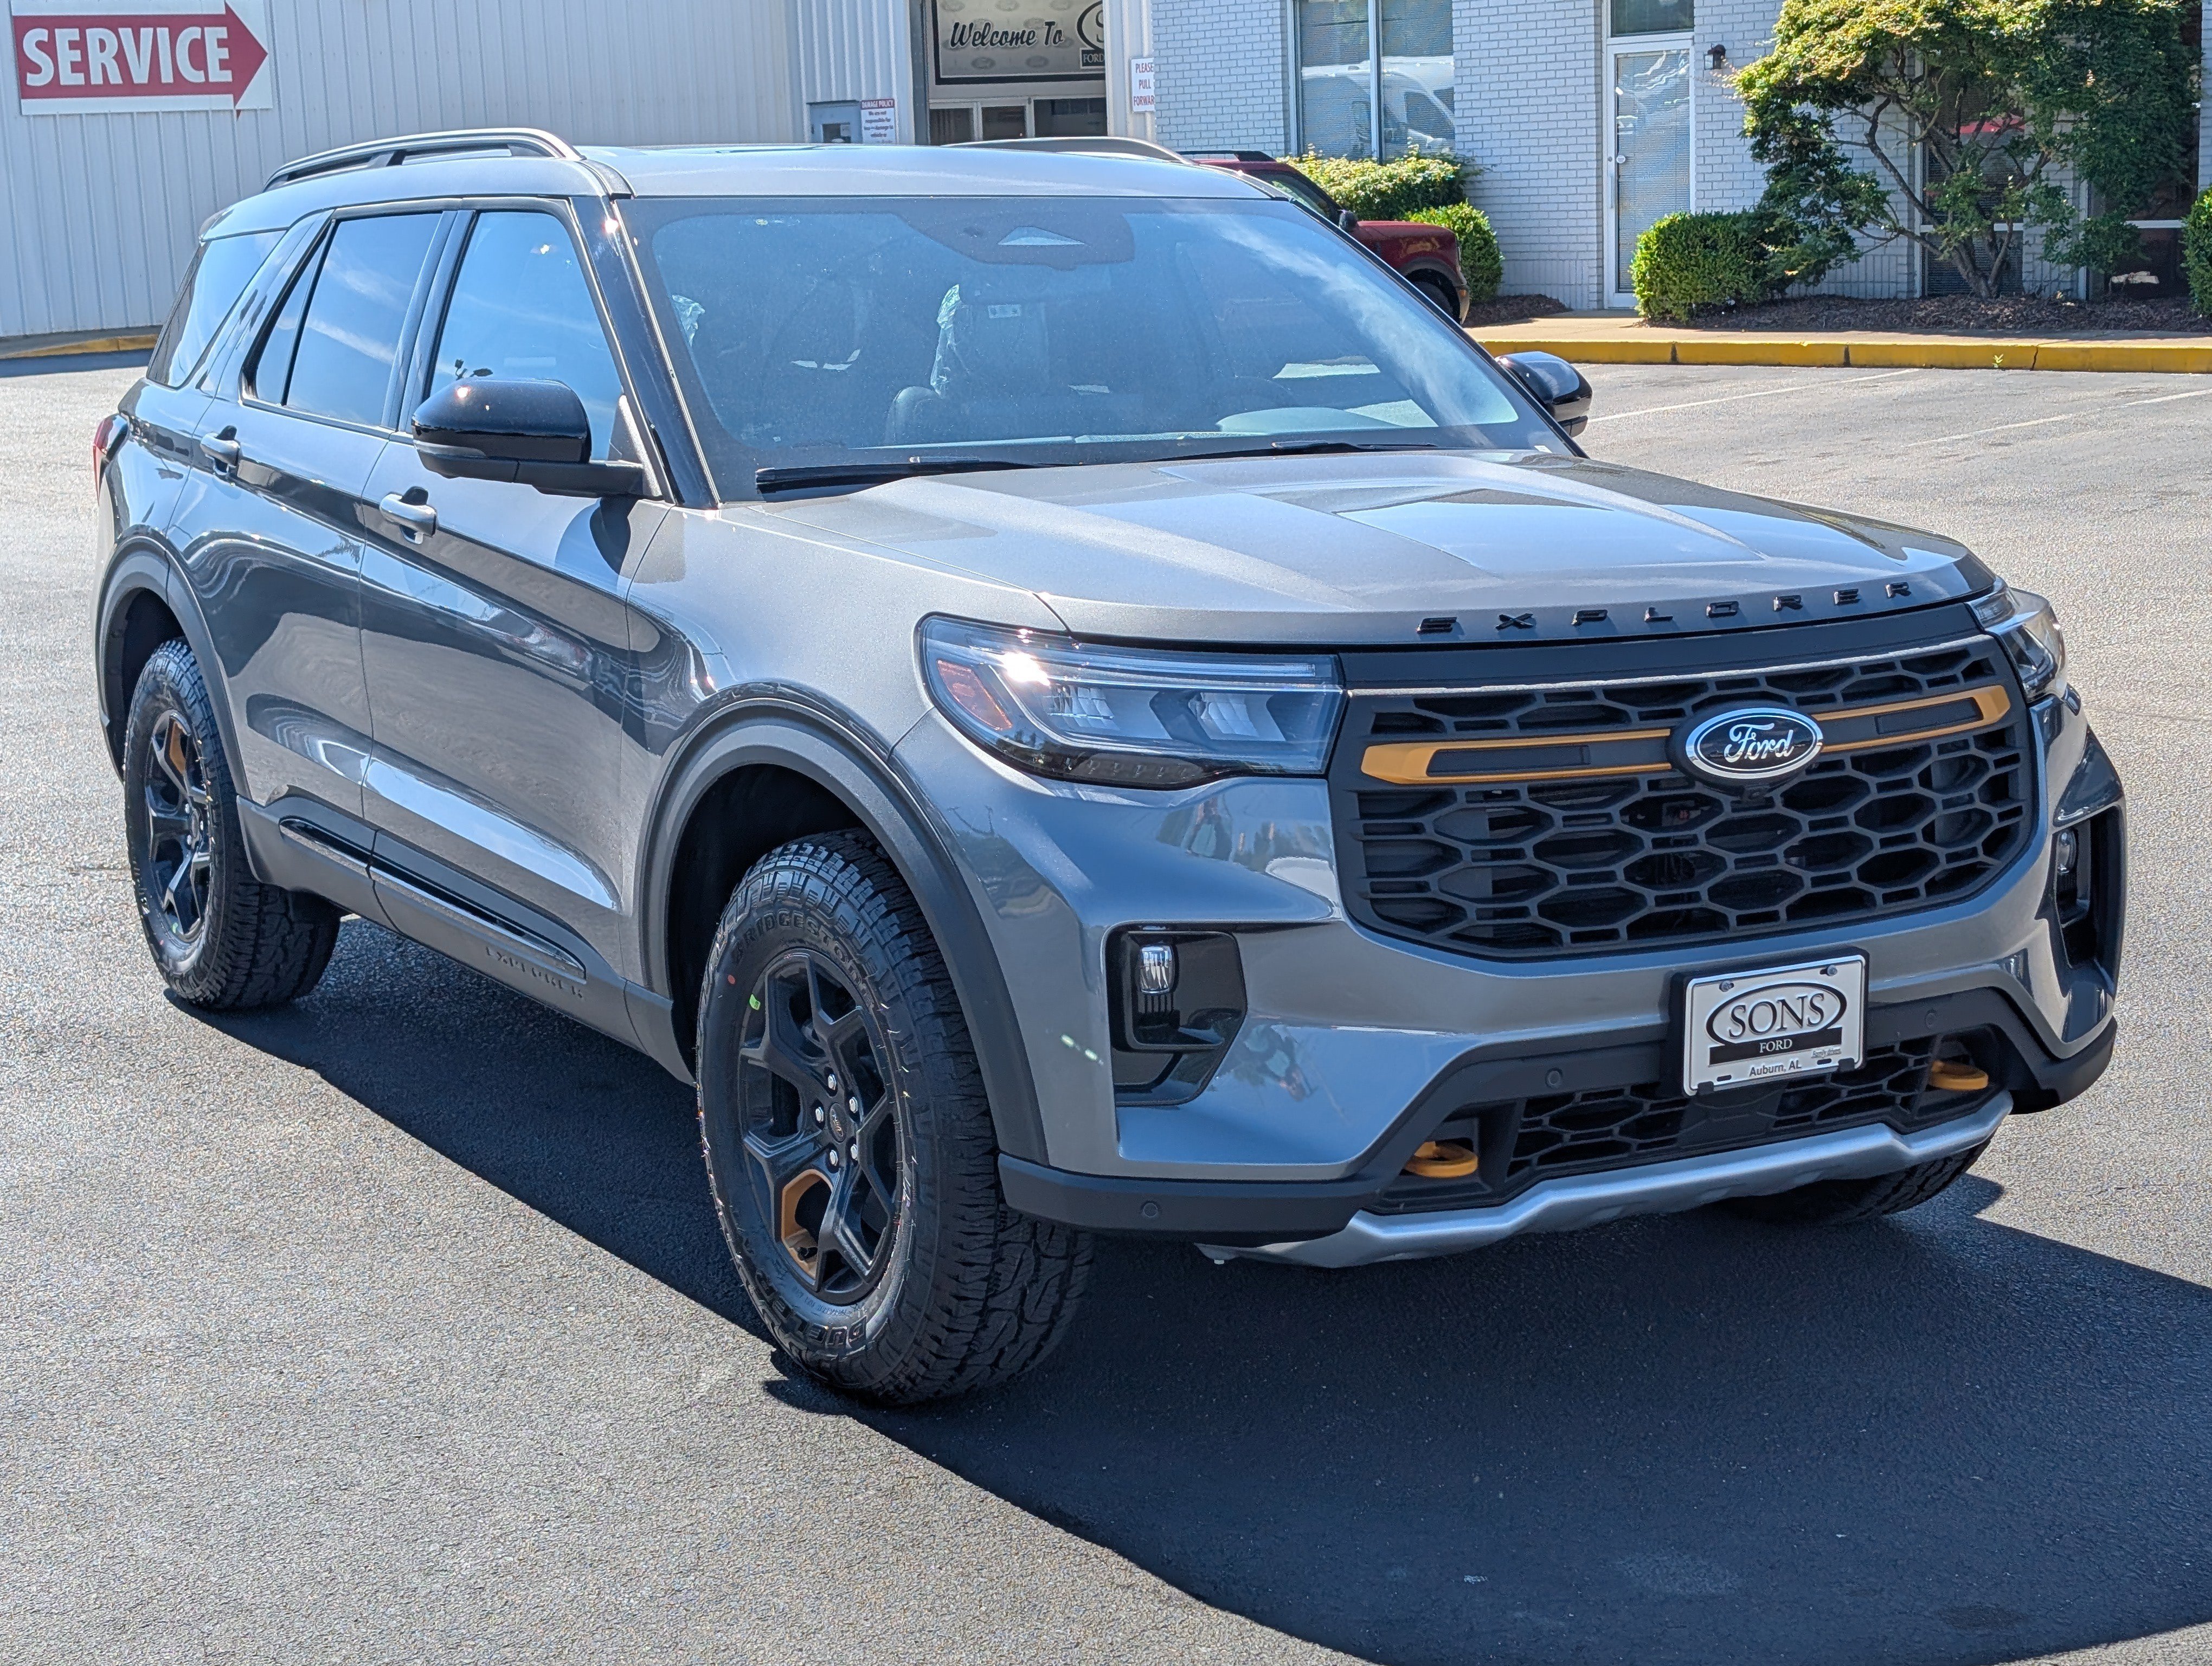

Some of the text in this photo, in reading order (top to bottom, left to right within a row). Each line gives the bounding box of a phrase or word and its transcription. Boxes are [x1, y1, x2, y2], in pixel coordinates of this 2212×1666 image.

[950, 21, 1064, 47] Welcome To
[23, 27, 233, 87] SERVICE
[1083, 54, 1104, 63] FORD
[1135, 62, 1154, 73] PLEASE
[1139, 79, 1151, 89] PULL
[1134, 95, 1154, 106] FORWAR
[1416, 582, 1911, 635] EXPLORER
[1724, 723, 1794, 762] Ford
[1728, 992, 1824, 1038] SONS
[1759, 1039, 1793, 1053] FORD
[1749, 1059, 1802, 1077] Auburn, AL
